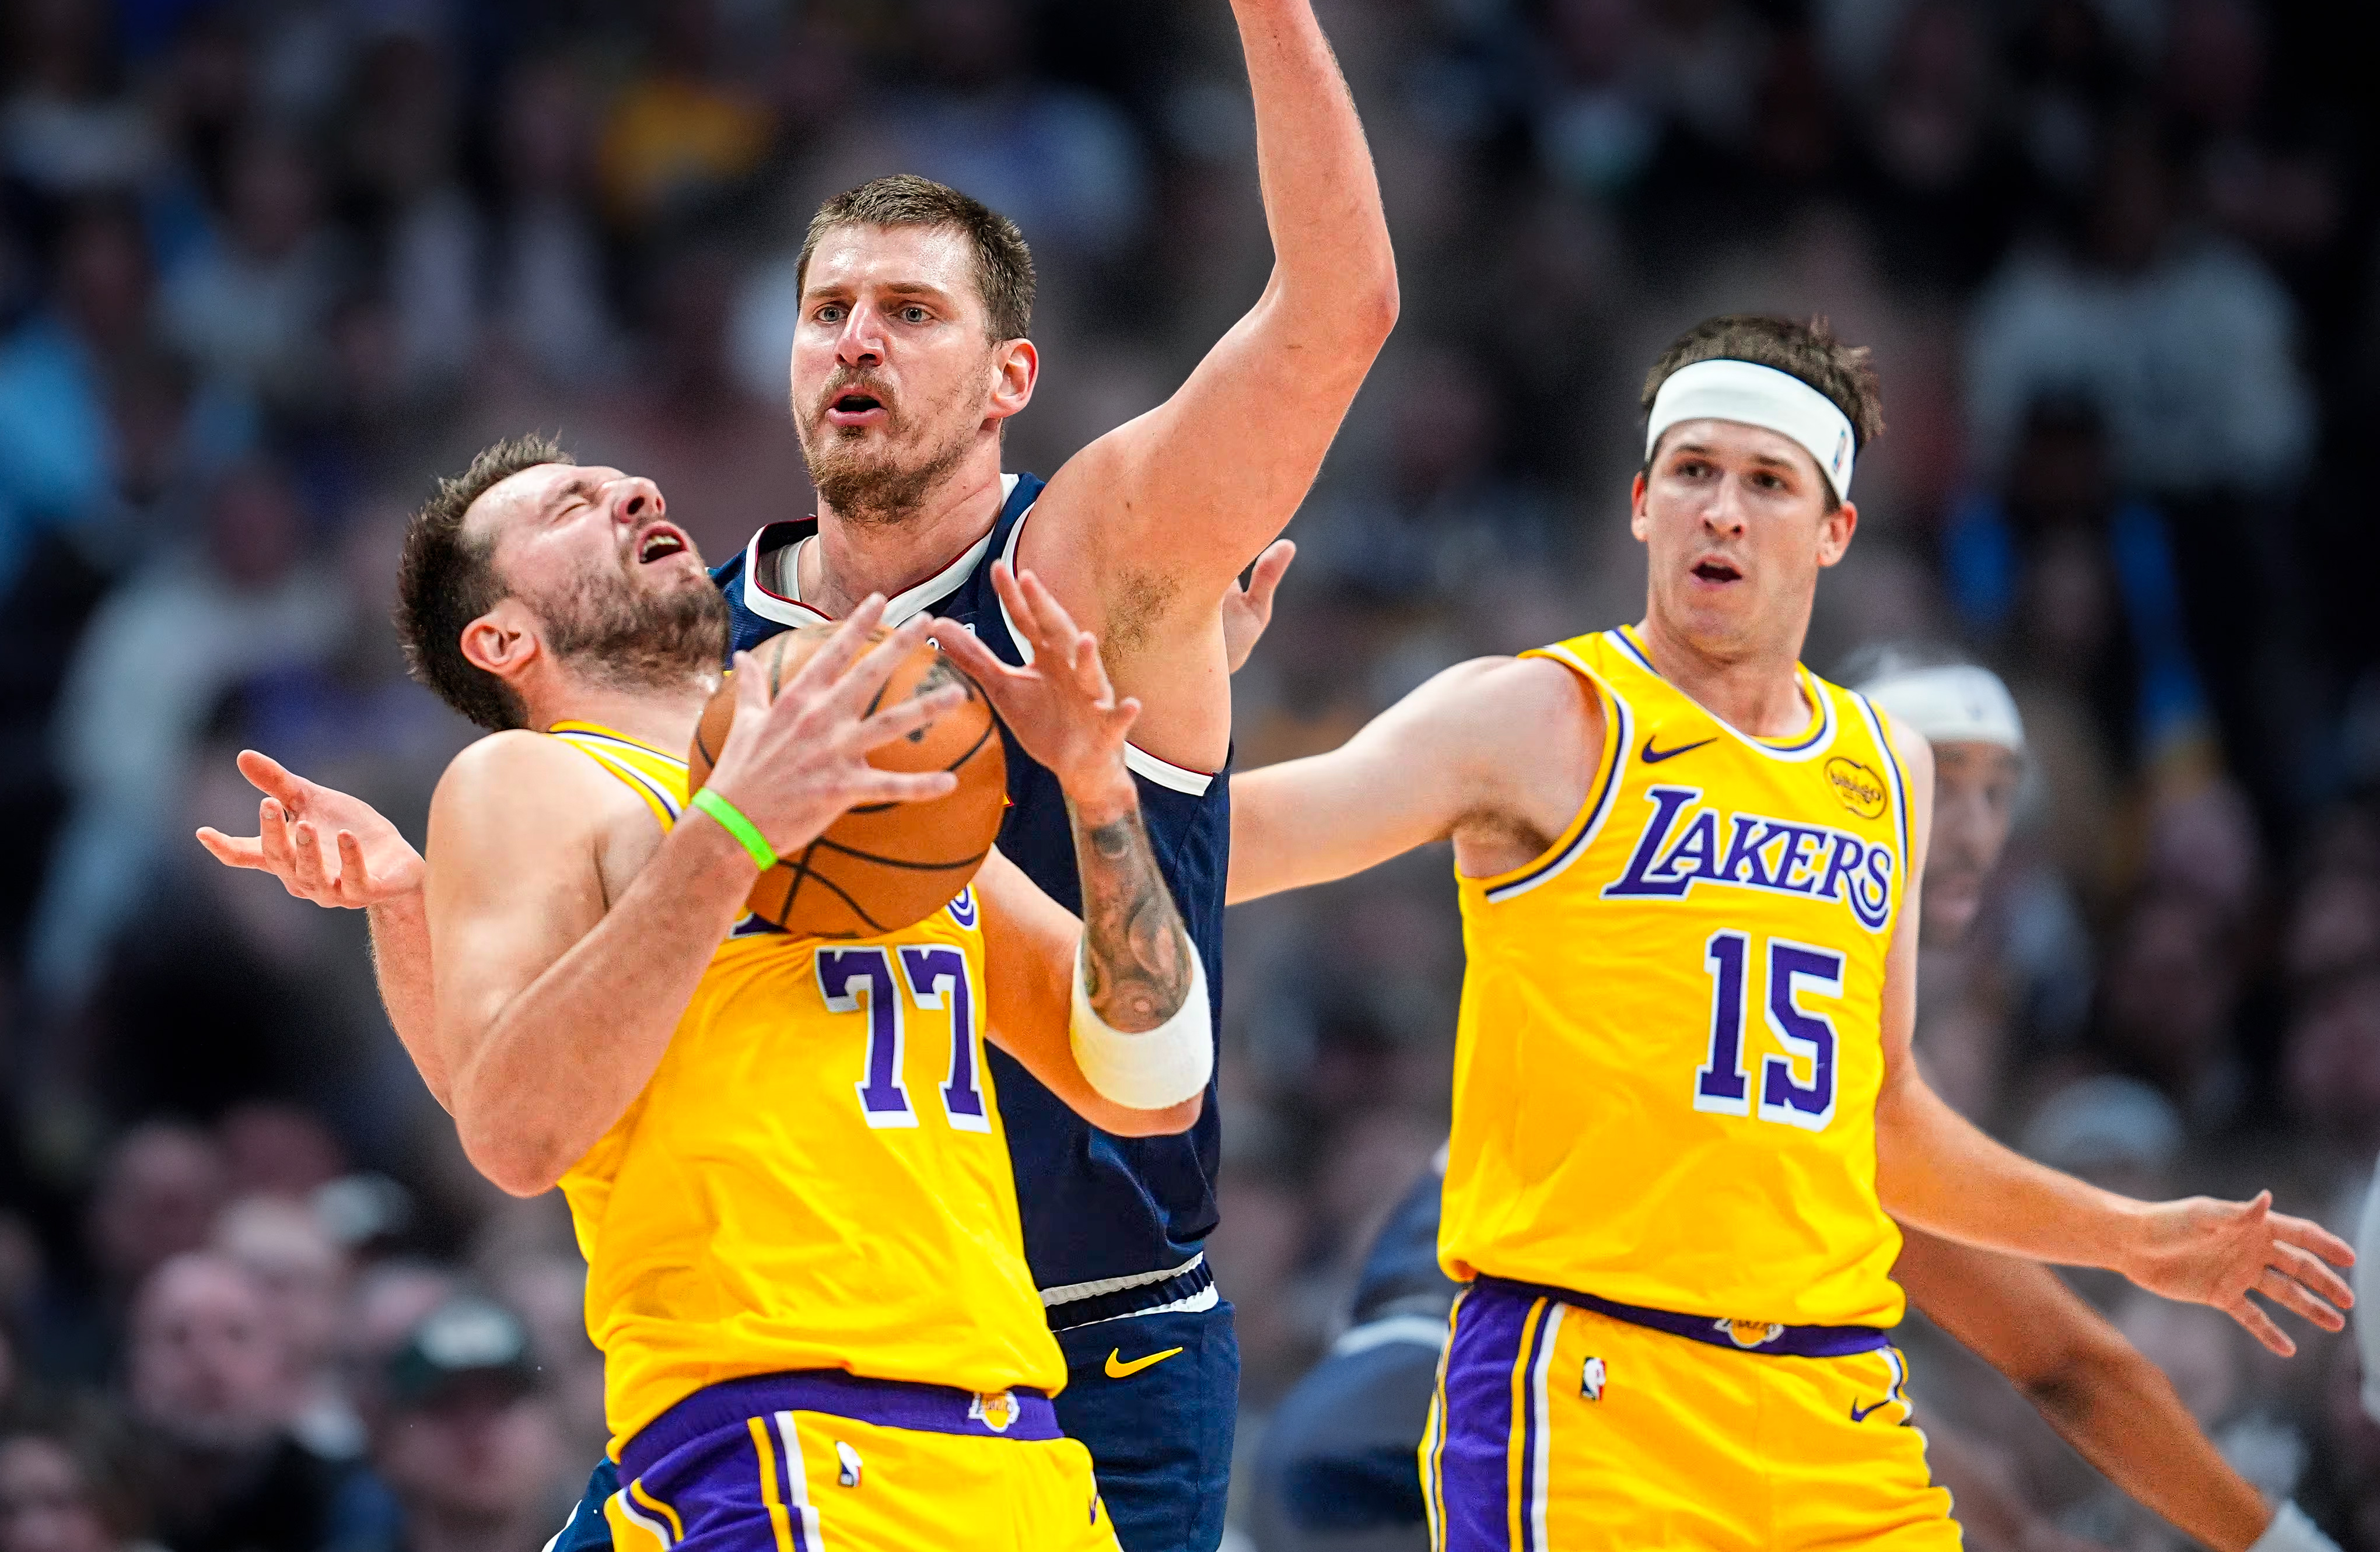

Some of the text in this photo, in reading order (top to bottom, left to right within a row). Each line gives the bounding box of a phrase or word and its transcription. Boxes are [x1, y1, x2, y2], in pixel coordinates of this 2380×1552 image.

[1601, 786, 1891, 932] LAKERS
[815, 944, 992, 1133] 77
[1694, 929, 1846, 1131] 15
